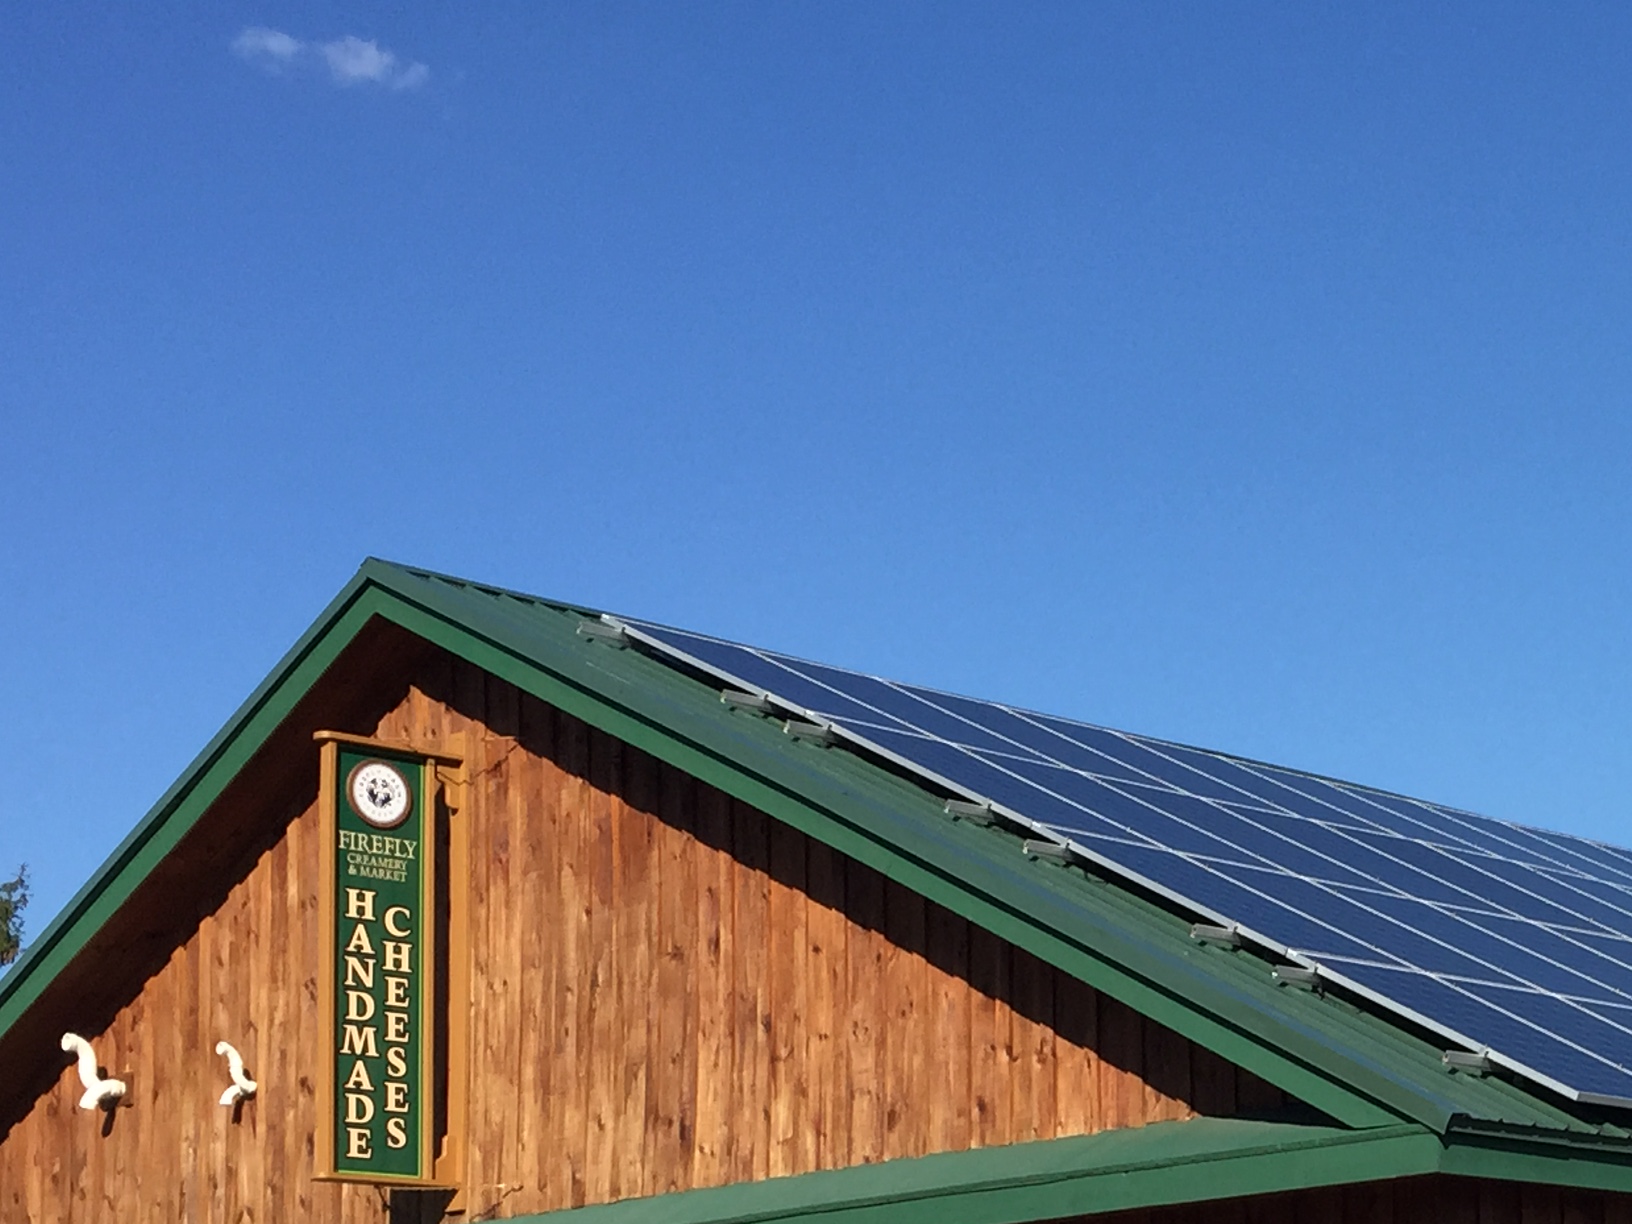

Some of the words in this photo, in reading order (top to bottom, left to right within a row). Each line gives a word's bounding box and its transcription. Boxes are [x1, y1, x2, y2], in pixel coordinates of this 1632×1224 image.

[338, 829, 418, 860] FIREFLY
[346, 852, 408, 871] CREAMERY
[347, 863, 358, 876] &
[359, 865, 408, 883] MARKET
[339, 887, 380, 1160] HANDMADE
[382, 907, 413, 1149] CHEESES
